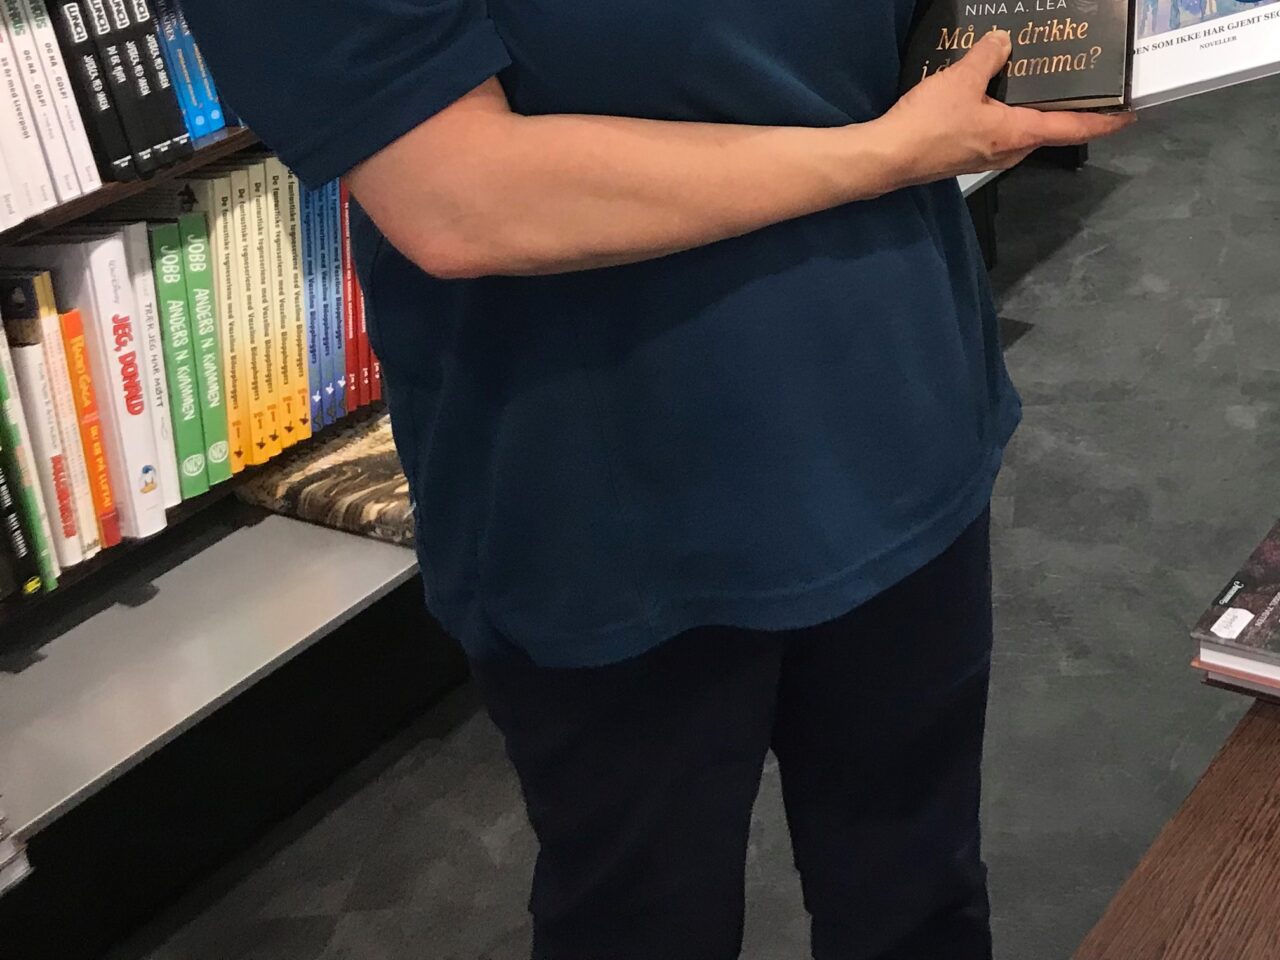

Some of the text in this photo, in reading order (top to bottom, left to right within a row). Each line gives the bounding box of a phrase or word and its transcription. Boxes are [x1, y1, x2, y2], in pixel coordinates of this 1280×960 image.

[67, 4, 87, 41] LUNCH
[965, 3, 1008, 17] NINA
[1014, 1, 1030, 14] A.
[936, 22, 975, 52] Må
[1018, 17, 1089, 46] drikke
[1151, 38, 1175, 53] SOM
[1176, 32, 1202, 48] IKKE
[1202, 25, 1226, 42] HAR
[1226, 15, 1262, 35] GJEMT
[1199, 34, 1237, 51] NOVELLER
[187, 233, 207, 273] JOBB
[158, 244, 175, 285] JOBB
[167, 299, 190, 353] ANDERS
[193, 288, 215, 337] ANDERS
[111, 313, 145, 416] JEG, DONALD
[154, 377, 165, 409] MØTT
